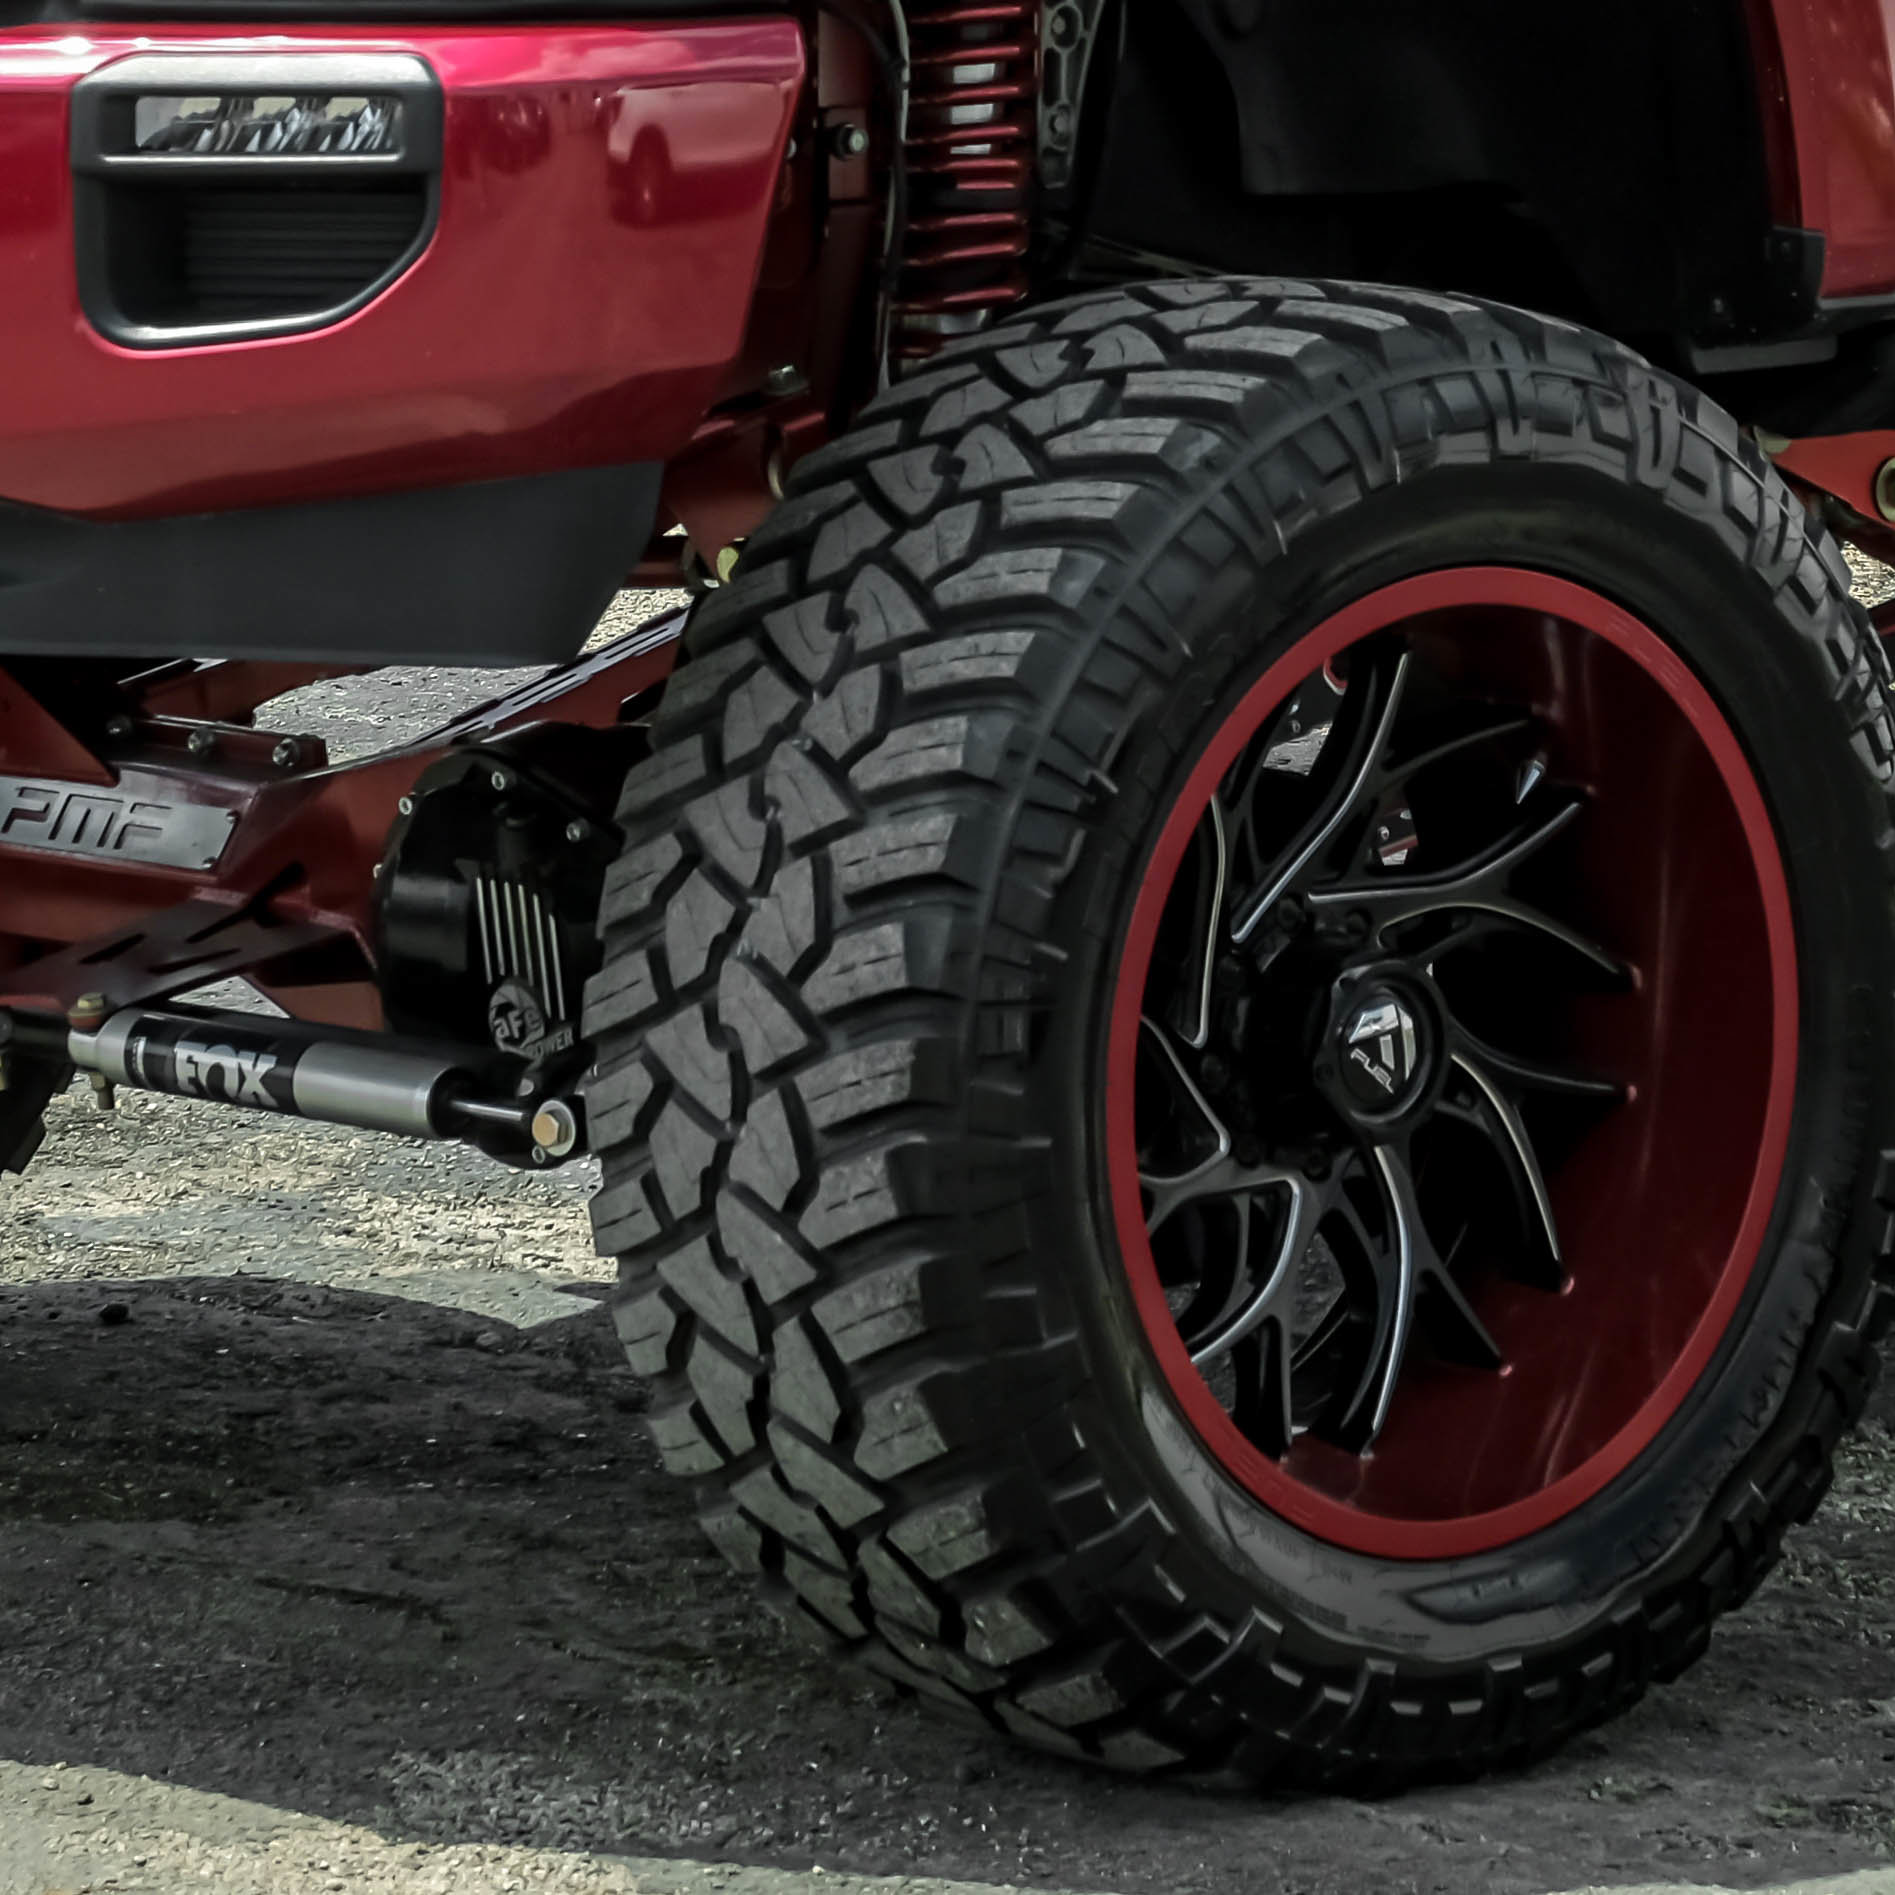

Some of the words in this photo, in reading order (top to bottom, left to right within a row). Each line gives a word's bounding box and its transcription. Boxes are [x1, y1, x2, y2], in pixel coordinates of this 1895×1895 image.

[0, 786, 172, 850] PMF
[174, 1040, 280, 1108] FOX
[1350, 1047, 1395, 1094] FUEL
